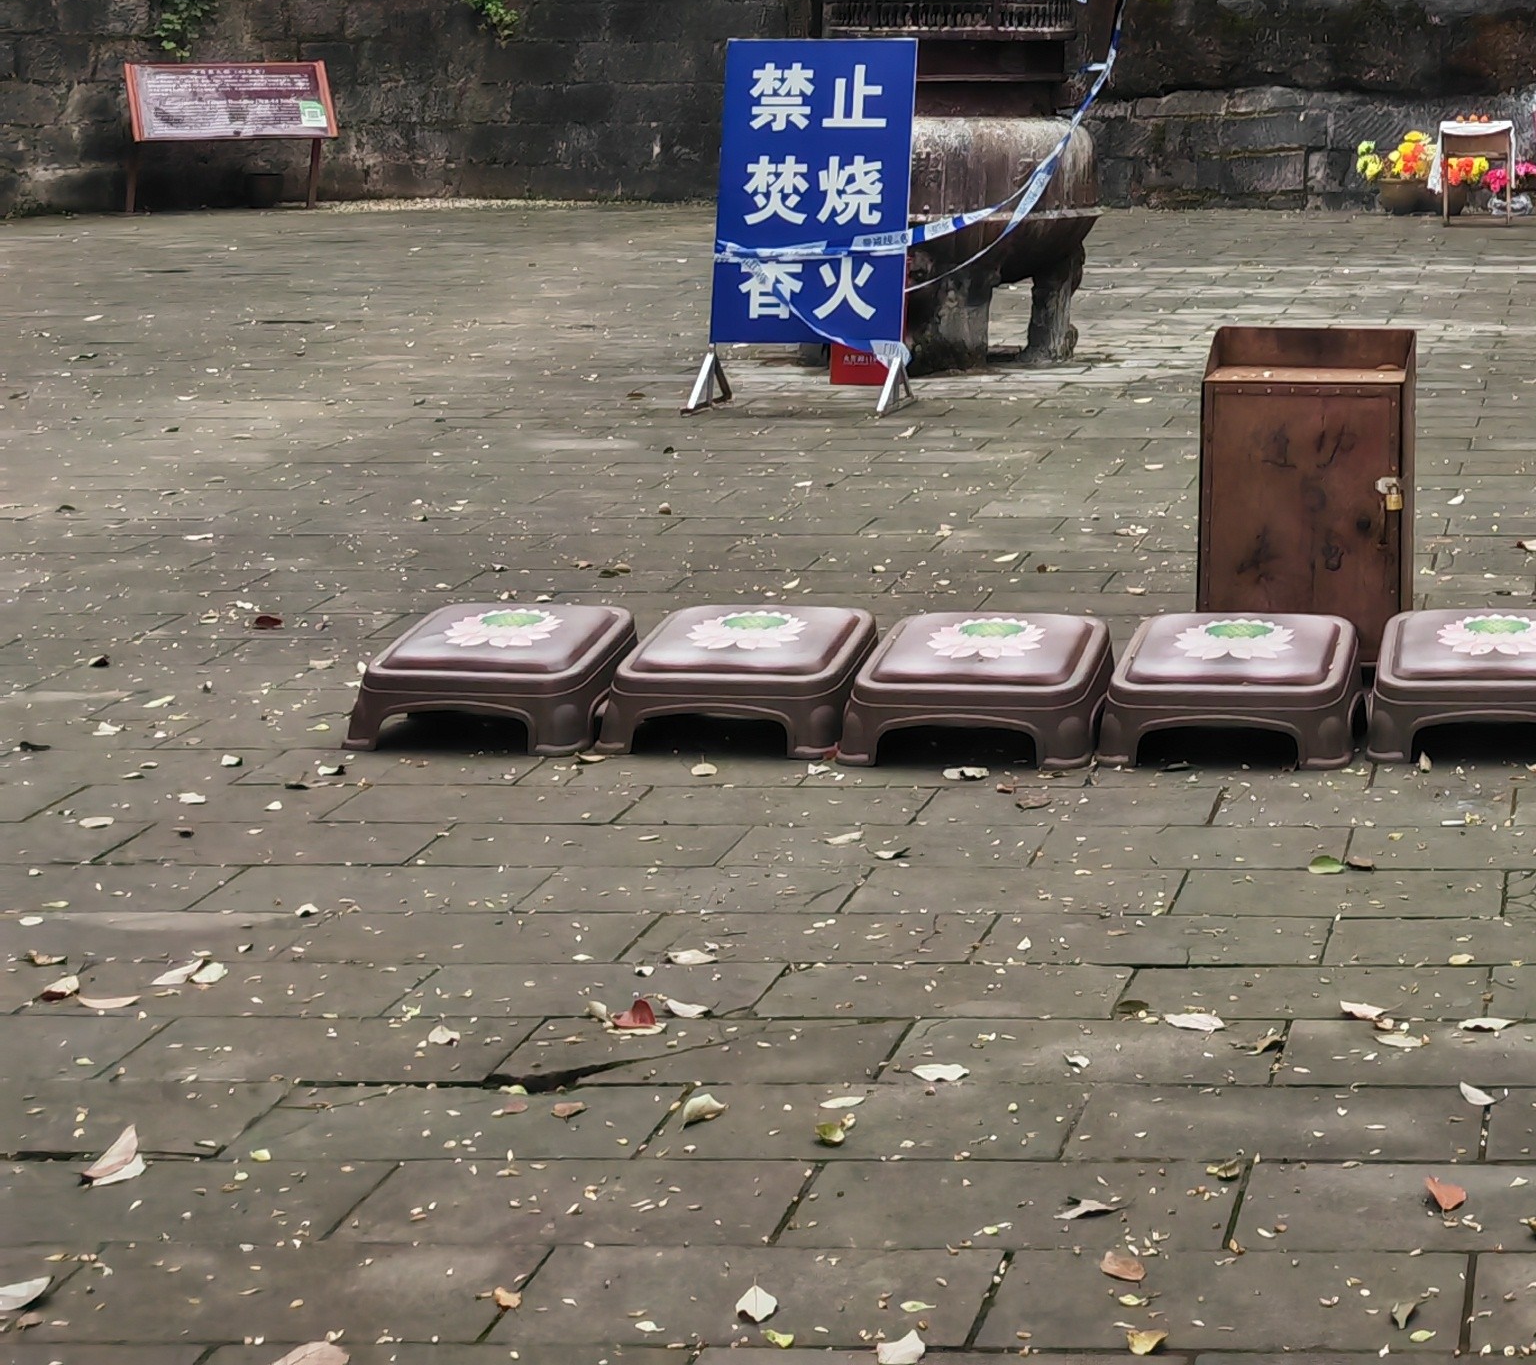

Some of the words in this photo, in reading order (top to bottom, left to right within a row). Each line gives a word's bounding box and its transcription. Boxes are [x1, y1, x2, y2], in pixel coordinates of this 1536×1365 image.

[749, 62, 887, 132] 禁止
[743, 155, 883, 226] 焚烧
[738, 258, 877, 321] 香火
